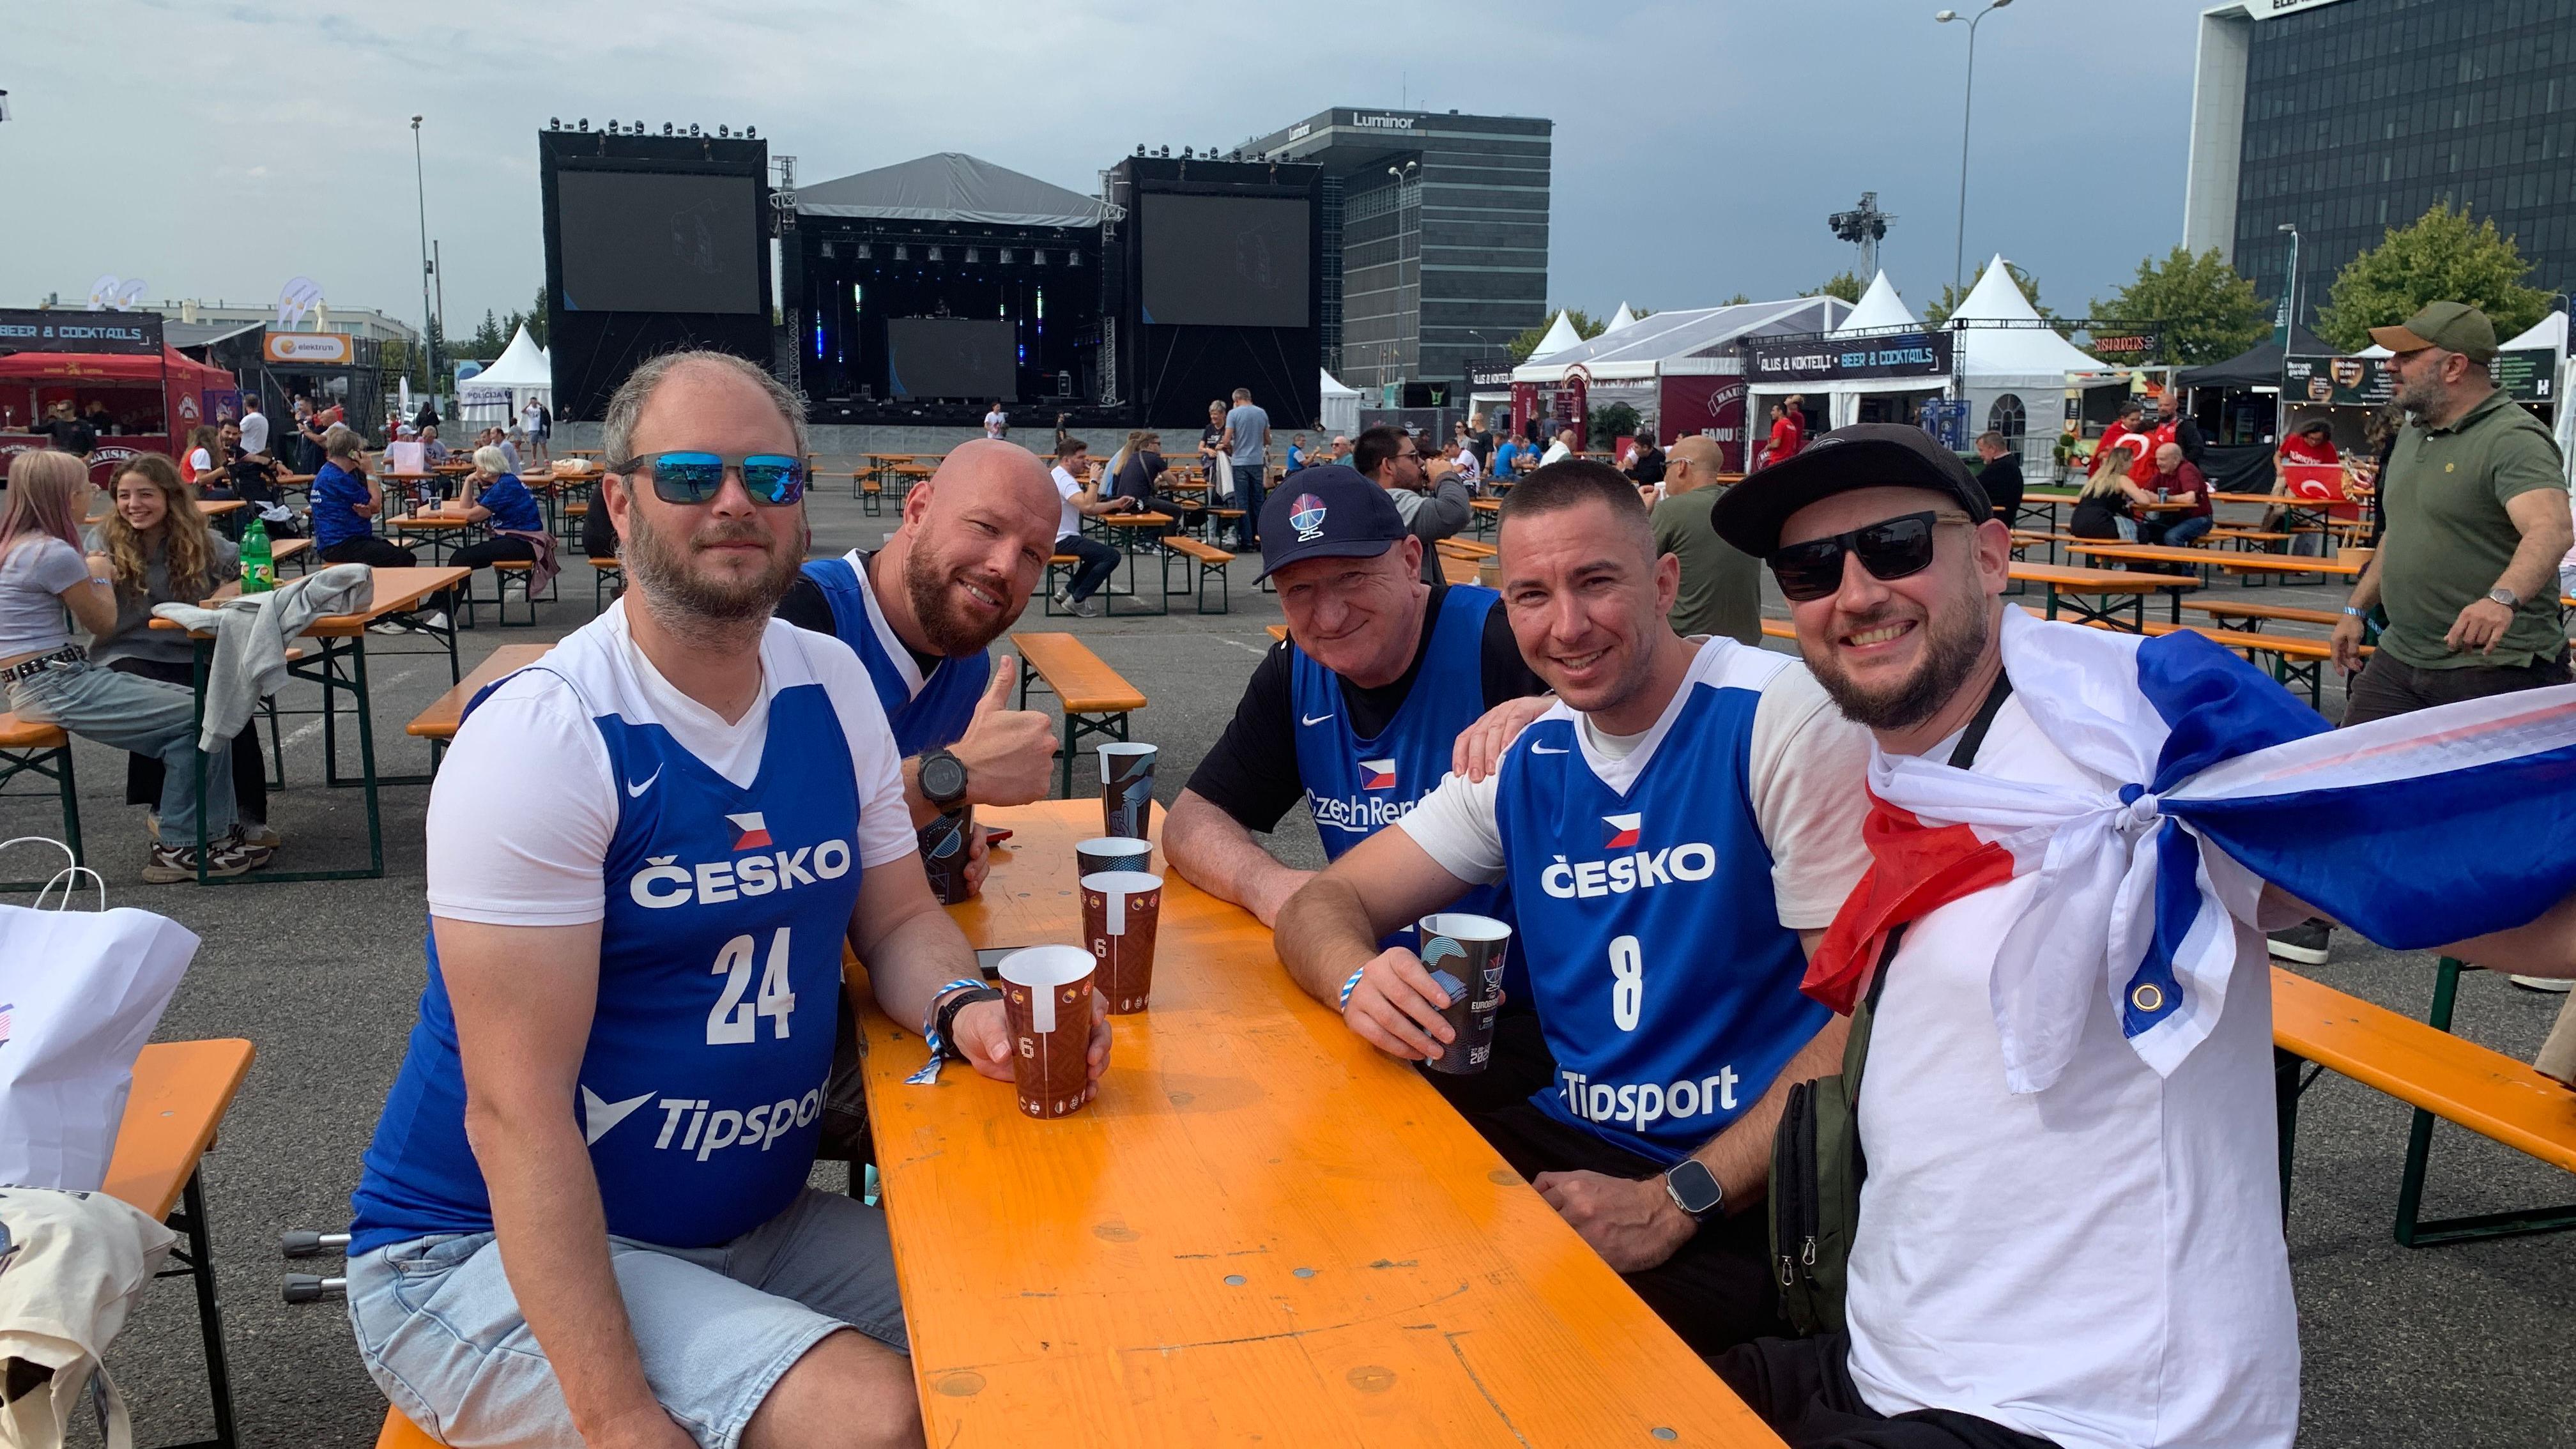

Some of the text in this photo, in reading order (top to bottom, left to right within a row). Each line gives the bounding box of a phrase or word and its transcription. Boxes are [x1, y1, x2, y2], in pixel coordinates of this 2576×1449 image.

[1353, 112, 1414, 129] Luminor
[0, 325, 142, 340] BEER & COCKTAILS
[298, 342, 334, 351] elektrum
[1761, 357, 1781, 371] ALUS
[1783, 356, 1790, 370] &
[1841, 353, 1866, 368] BEER
[1869, 351, 1876, 366] &
[1879, 348, 1933, 365] COCKTAILS
[468, 390, 503, 399] POLICIJA
[1298, 526, 1324, 542] 25
[630, 839, 851, 909] ČESKO
[1541, 842, 1715, 899] ČESKO
[707, 926, 796, 1046] 24
[1608, 935, 1643, 1032] 8
[654, 1061, 833, 1162] Tipspor
[1562, 1064, 1738, 1132] Tipsport
